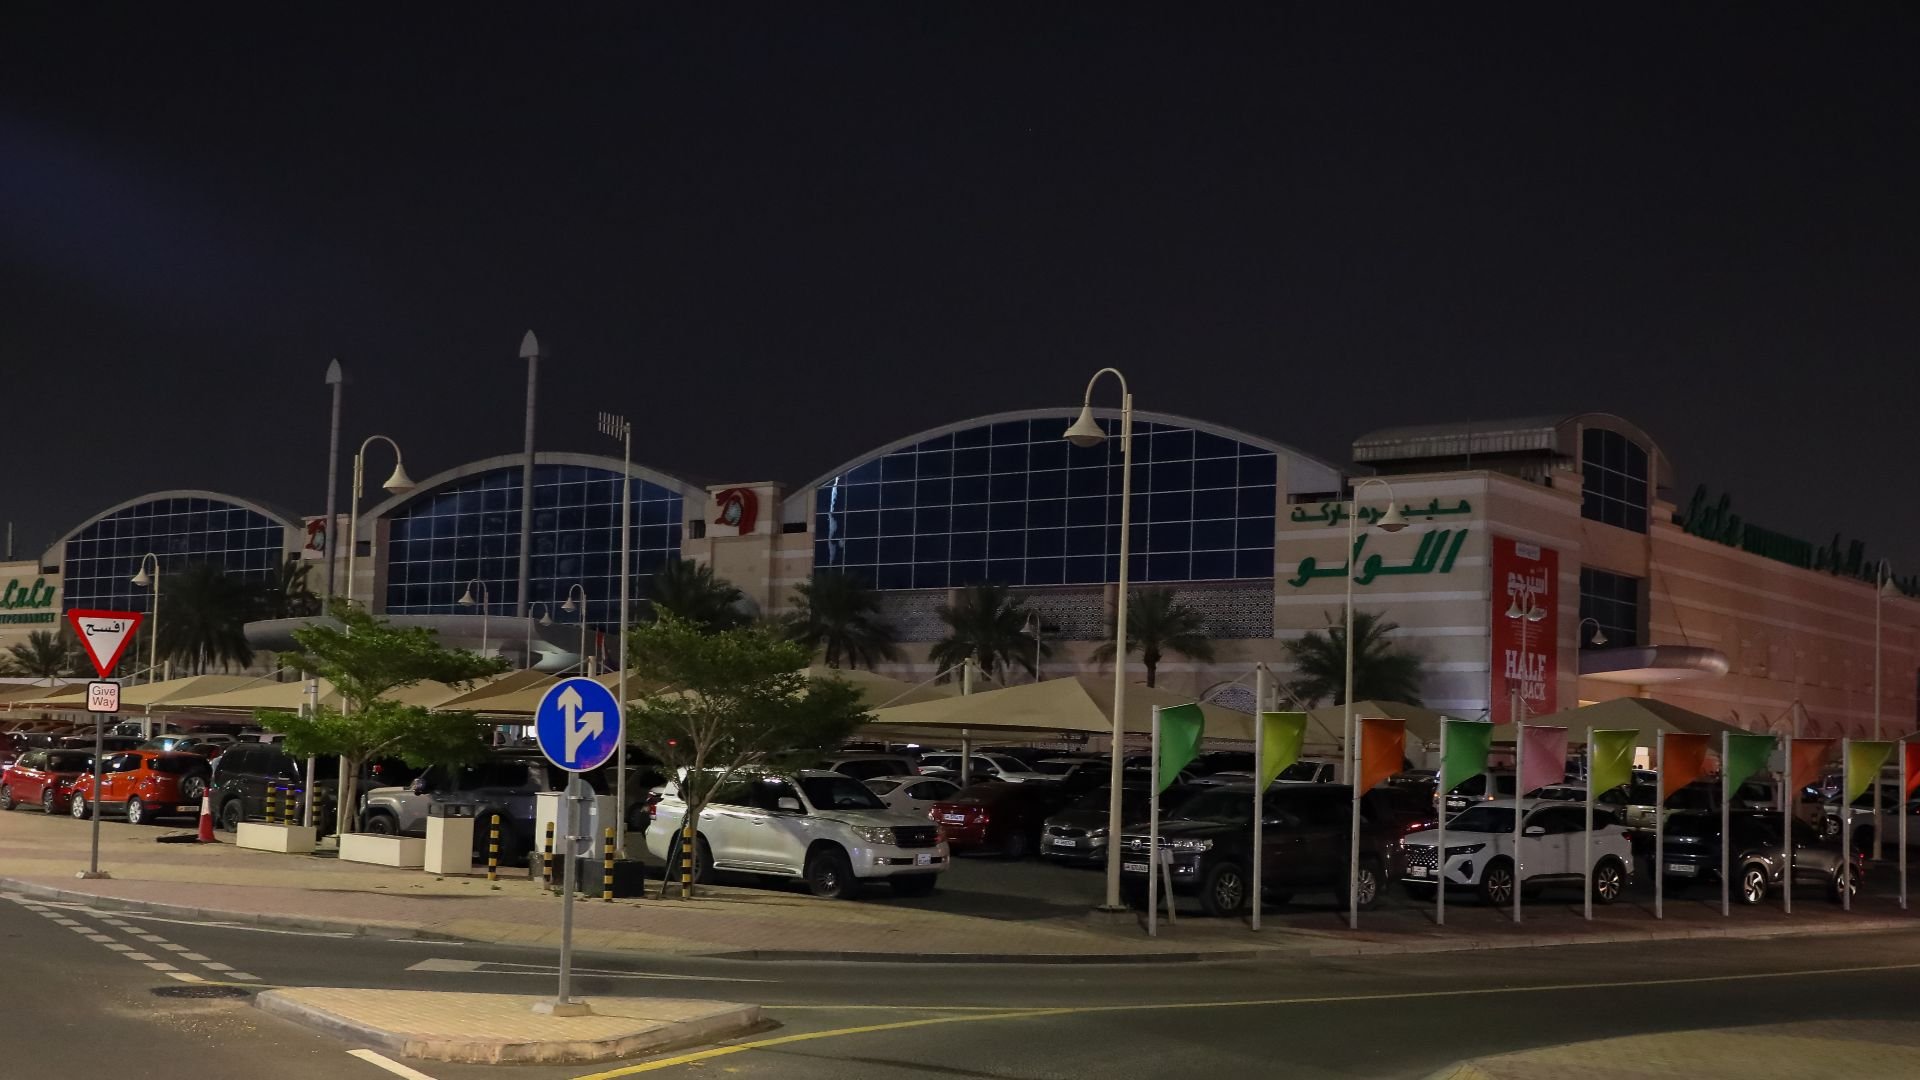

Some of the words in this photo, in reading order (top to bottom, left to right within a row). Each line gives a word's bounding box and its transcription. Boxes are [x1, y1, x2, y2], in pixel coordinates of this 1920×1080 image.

[86, 620, 125, 636] افسح
[1504, 649, 1547, 682] HALF
[92, 685, 116, 696] Give
[92, 697, 116, 708] Way
